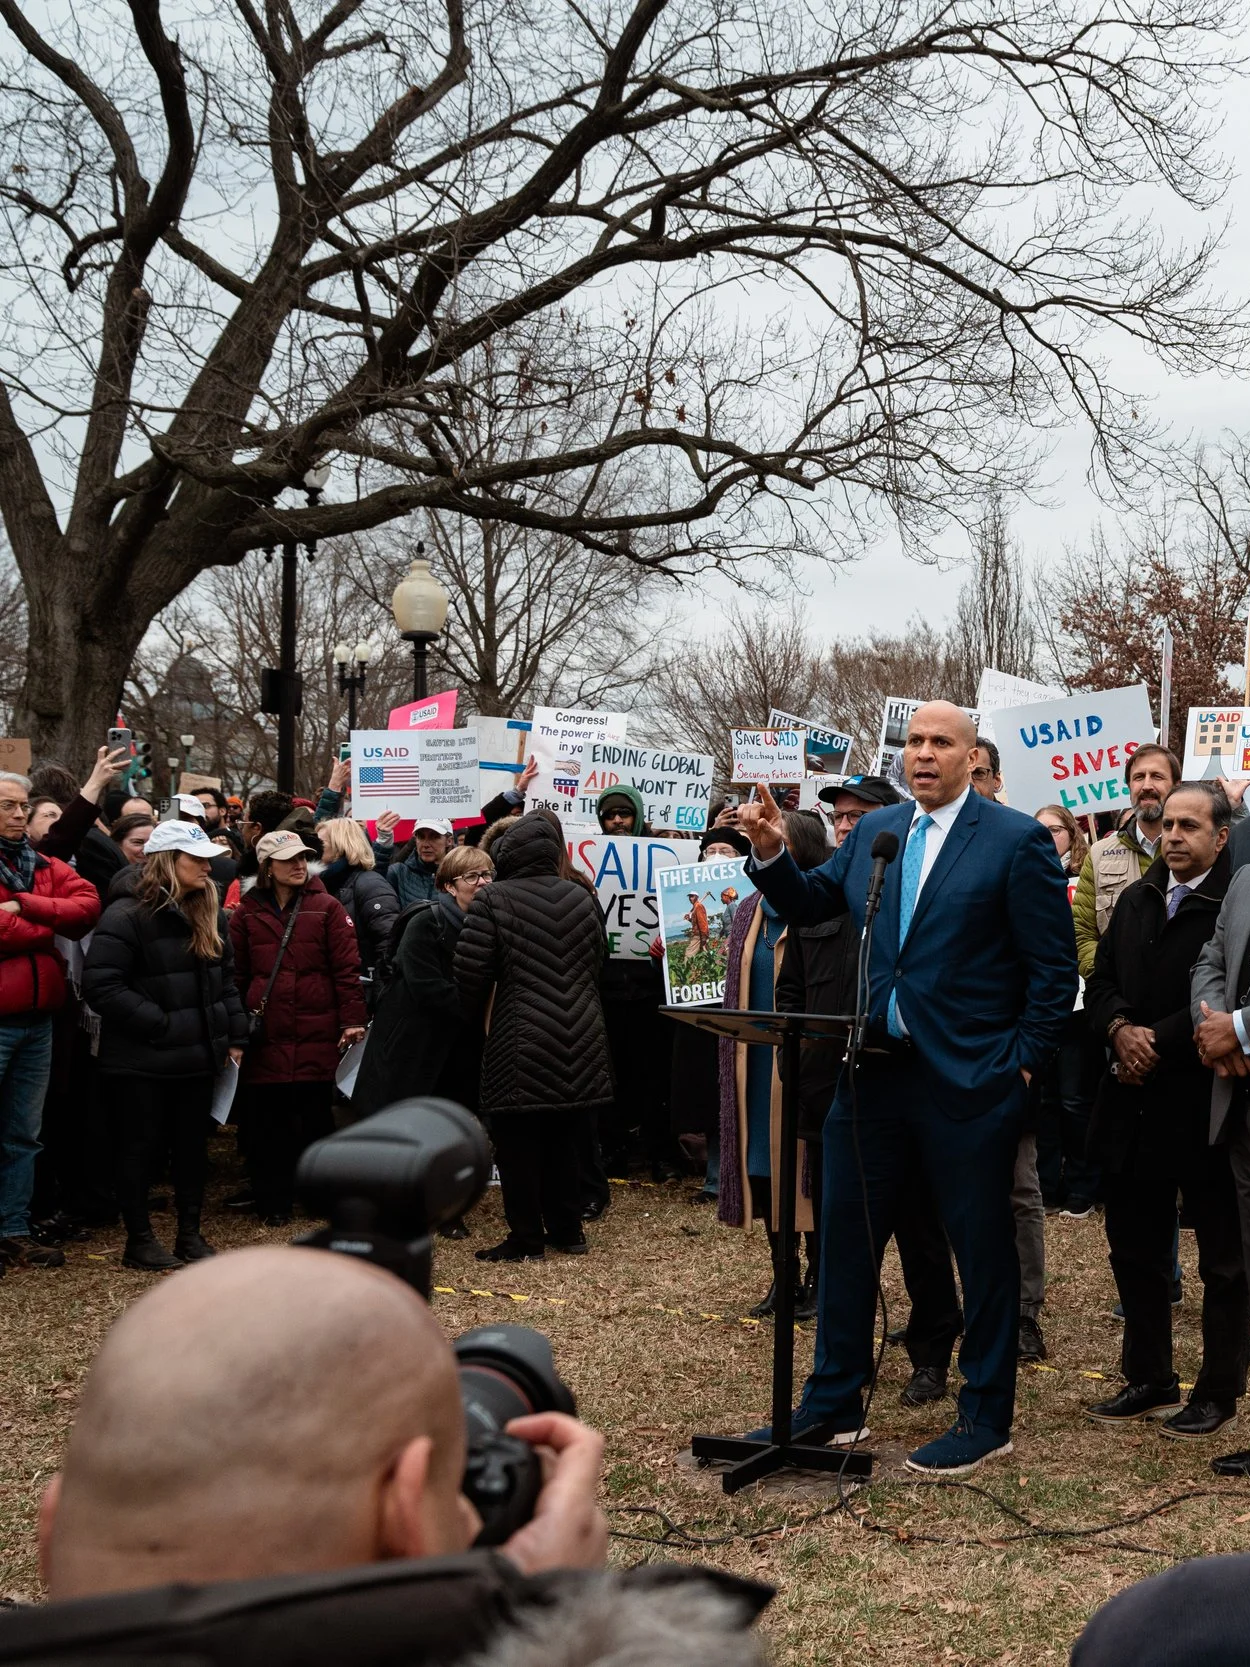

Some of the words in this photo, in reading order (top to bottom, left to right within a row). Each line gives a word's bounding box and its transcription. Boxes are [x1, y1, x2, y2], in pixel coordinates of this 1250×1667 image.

[419, 707, 437, 718] USAID
[555, 712, 608, 726] Congress!
[1199, 712, 1241, 723] USAID
[540, 726, 559, 736] The
[560, 728, 595, 739] power
[597, 731, 606, 741] is
[735, 730, 762, 747] SAVE
[764, 731, 799, 747] USAID
[1019, 715, 1103, 749] USAID
[559, 742, 568, 751] in
[570, 745, 583, 755] yo
[832, 737, 849, 751] OF
[363, 747, 409, 758] USAID
[592, 744, 647, 768] ENDING
[651, 753, 705, 777] GLOBAL
[733, 748, 775, 764] Protecting
[777, 752, 798, 761] Lives
[1051, 741, 1141, 781] SAVES
[736, 764, 770, 781] Securing
[584, 770, 620, 789] AID
[632, 777, 677, 796] WON'T
[685, 782, 711, 800] FIX
[532, 798, 559, 812] Take
[563, 800, 572, 812] it
[579, 797, 598, 814] TH
[660, 804, 671, 823] of
[675, 806, 707, 827] EGGS
[1102, 848, 1127, 856] DART
[568, 840, 681, 893] SAID
[661, 869, 690, 888] THE
[693, 862, 737, 883] FACES
[672, 980, 726, 1003] FOREIG
